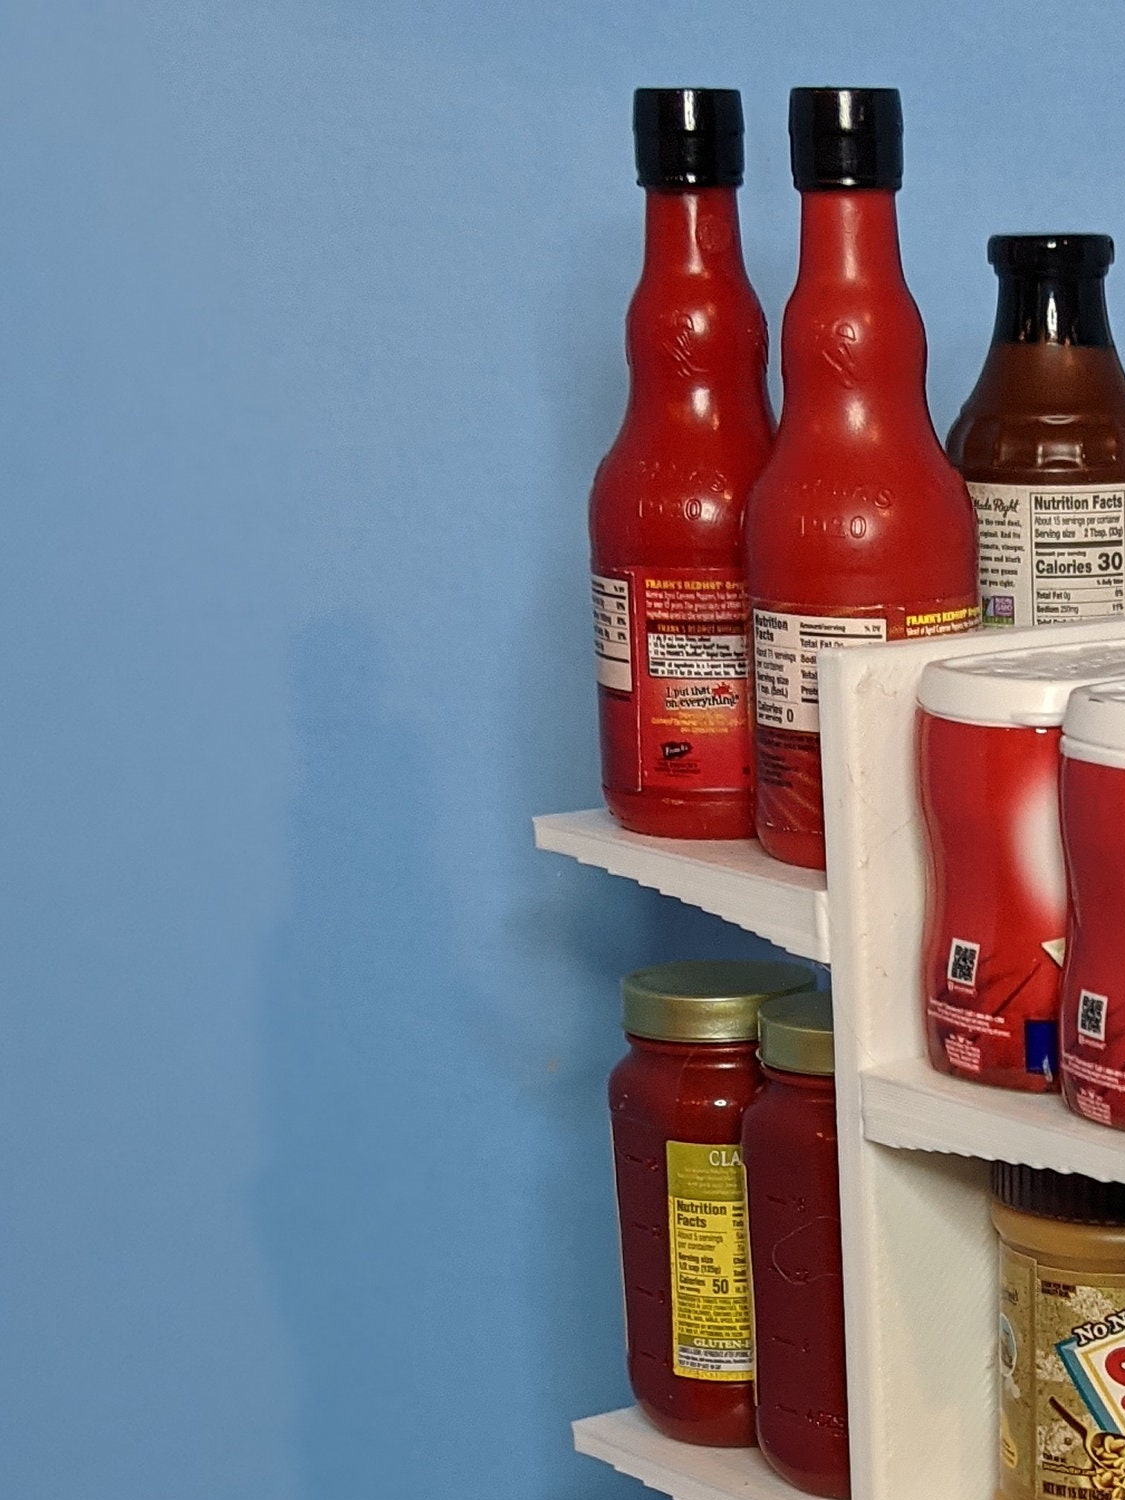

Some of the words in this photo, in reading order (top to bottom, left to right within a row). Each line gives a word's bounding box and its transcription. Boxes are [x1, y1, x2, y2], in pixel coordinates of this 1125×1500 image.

[1034, 496, 1089, 511] Nutrition
[1092, 494, 1123, 509] Facts
[1034, 516, 1051, 526] About
[1062, 516, 1085, 528] servings
[1096, 515, 1120, 525] container
[1034, 528, 1060, 541] Serving
[1062, 528, 1075, 538] size
[1090, 528, 1107, 539] Tbsp.
[1035, 560, 1092, 575] Calories
[1098, 551, 1123, 571] 30
[1037, 590, 1051, 599] Total
[1052, 590, 1062, 599] Fat
[1037, 604, 1059, 613] Sodium
[755, 614, 789, 631] Nutrition
[756, 627, 774, 642] Facts
[801, 638, 818, 648] Total
[674, 687, 689, 698] put
[691, 686, 710, 696] that
[680, 695, 736, 708] everything
[786, 709, 794, 723] 0
[709, 1150, 741, 1167] CLA
[677, 1200, 727, 1215] Nutrition
[677, 1214, 707, 1228] Facts
[679, 1274, 706, 1286] Calories
[712, 1278, 729, 1294] 50
[1073, 1322, 1108, 1345] No
